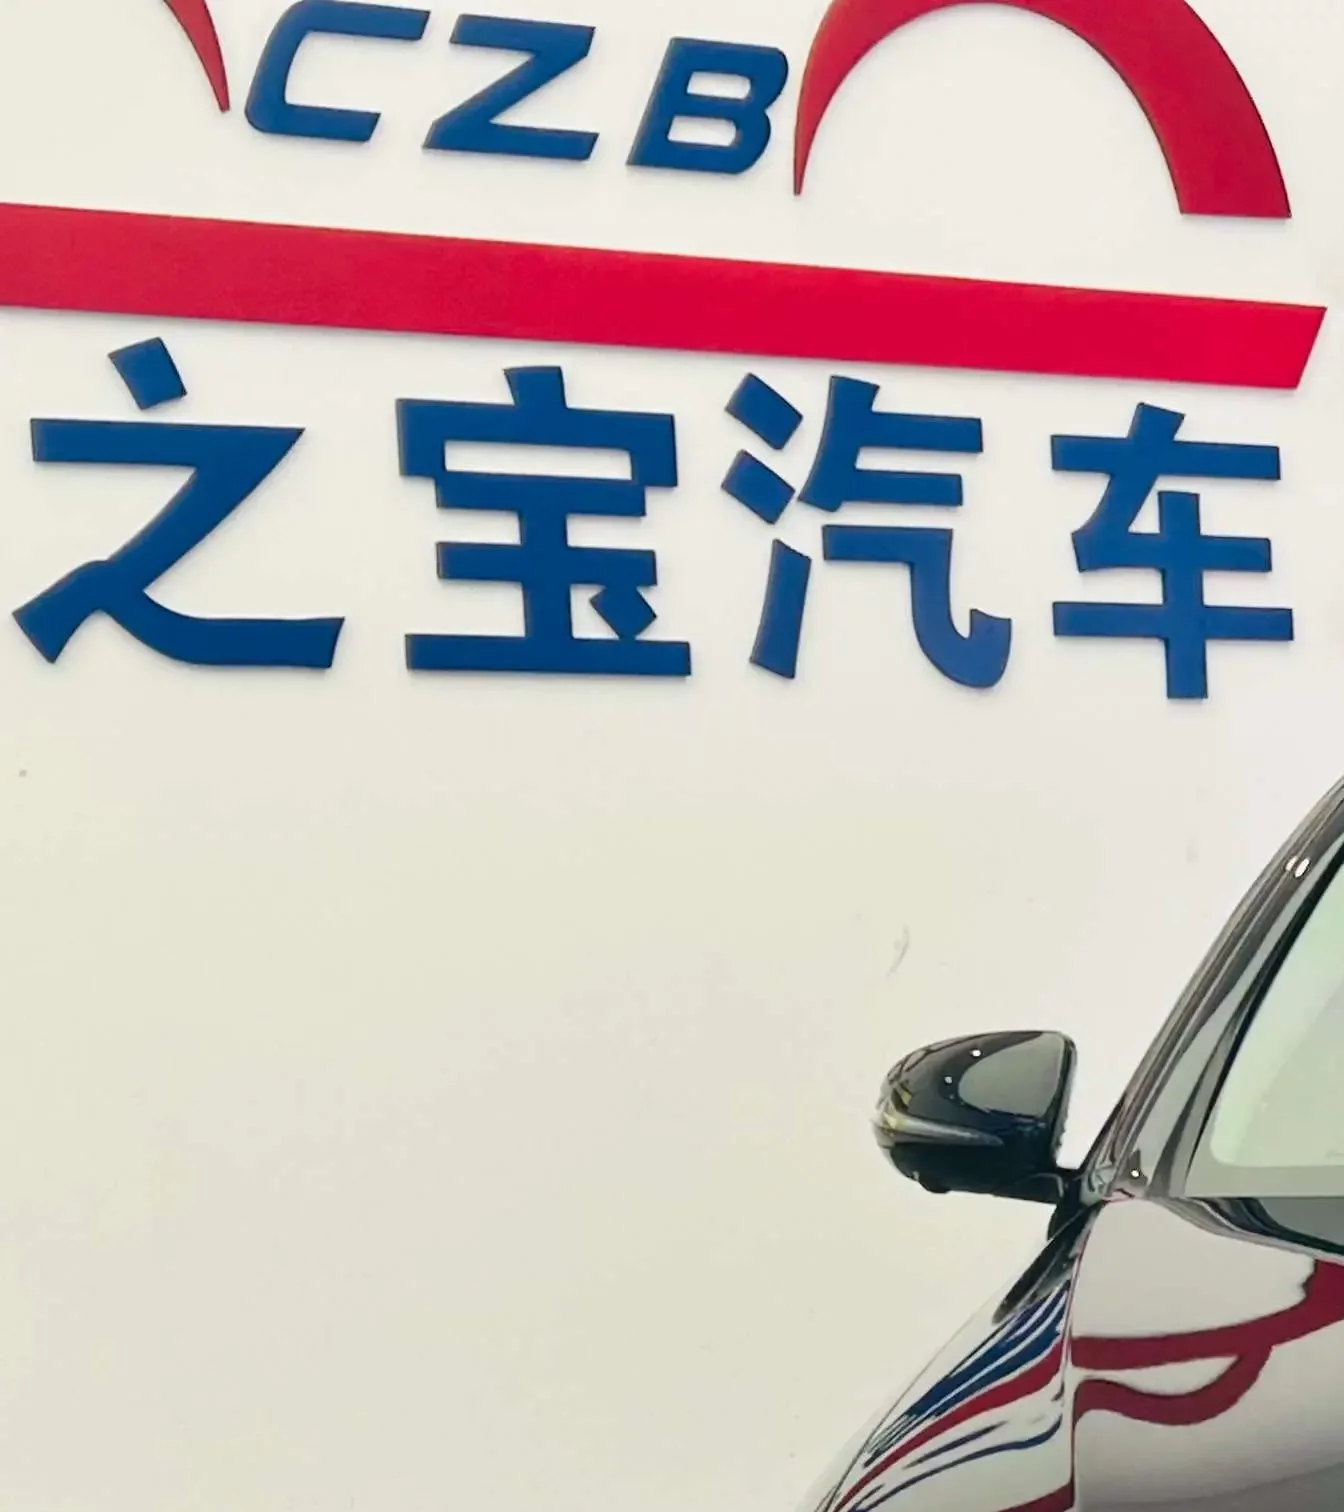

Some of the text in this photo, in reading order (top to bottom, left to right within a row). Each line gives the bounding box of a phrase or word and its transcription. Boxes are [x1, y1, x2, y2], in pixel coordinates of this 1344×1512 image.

[243, 0, 789, 175] CZB
[15, 336, 1295, 700] 之宝汽车
